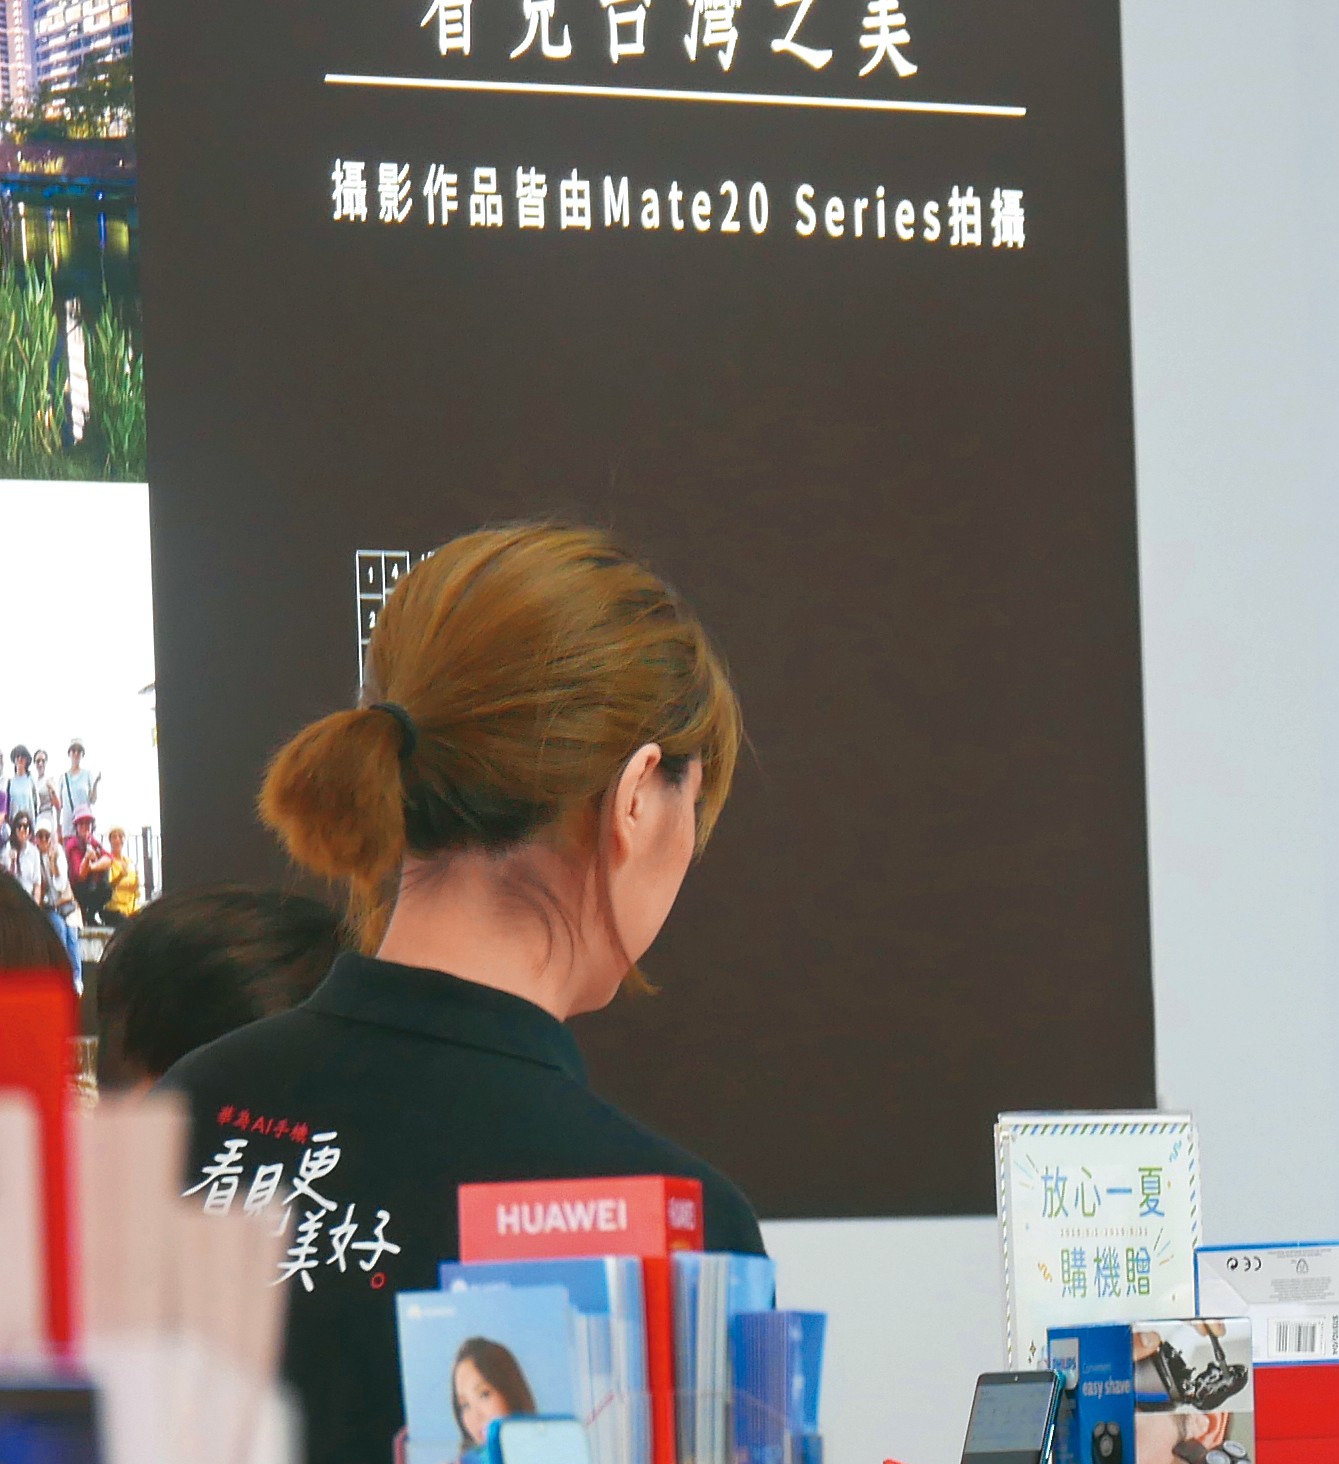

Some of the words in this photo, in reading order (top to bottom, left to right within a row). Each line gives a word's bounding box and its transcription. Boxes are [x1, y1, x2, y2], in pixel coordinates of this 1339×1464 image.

[1041, 1166, 1165, 1217] 放心一夏
[496, 1198, 628, 1236] HUAWEI
[1061, 1247, 1151, 1298] 購機贈
[1082, 1381, 1103, 1399] easy
[1105, 1376, 1130, 1395] shave
